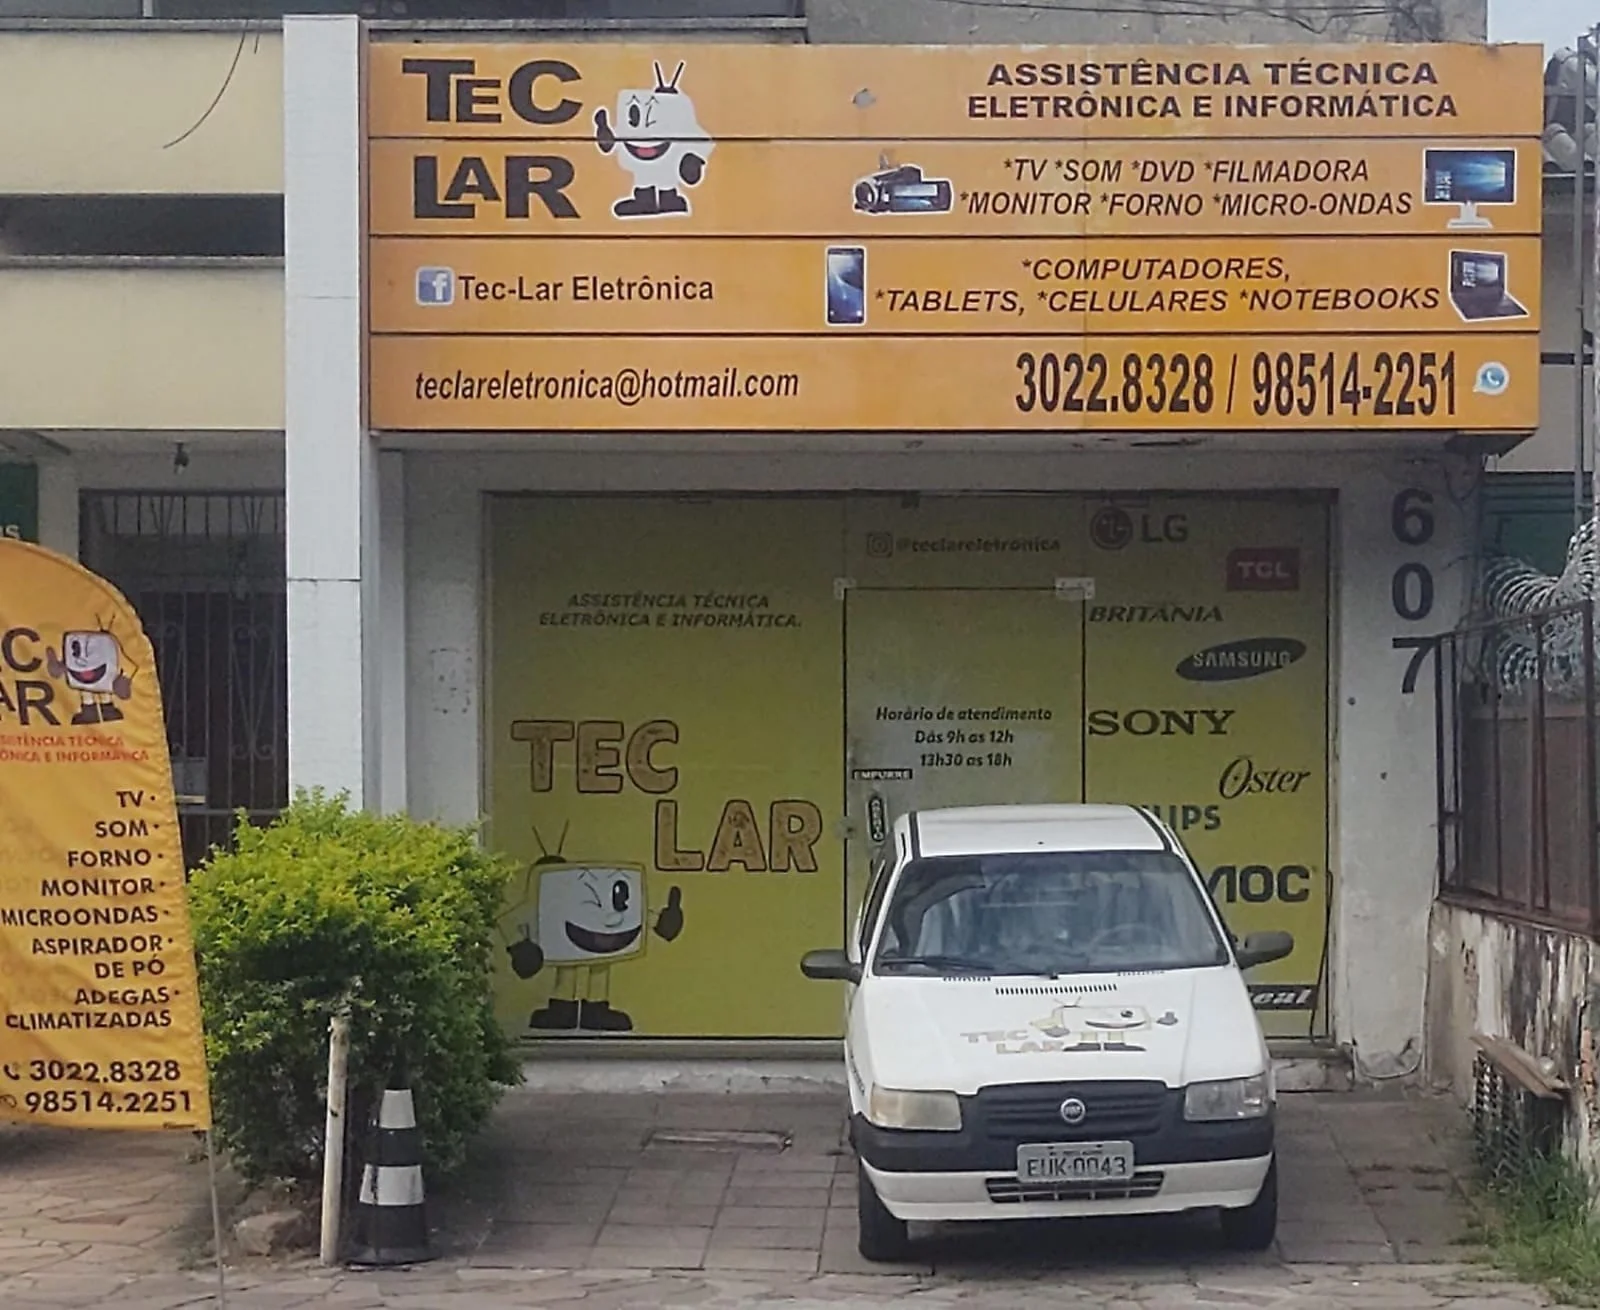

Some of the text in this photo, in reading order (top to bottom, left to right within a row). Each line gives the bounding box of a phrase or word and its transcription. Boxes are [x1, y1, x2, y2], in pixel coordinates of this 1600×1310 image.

[987, 58, 1438, 86] ASSISTÊNCIA TÉCNICA
[403, 59, 582, 124] TEC
[968, 89, 1458, 118] ELETRÔNICA E INFORMÁTICA
[414, 156, 580, 219] LAR
[459, 275, 563, 300] Tec-Lar
[572, 275, 714, 300] Eletrônica
[415, 368, 799, 405] teclareletronica@hotmail.com
[1016, 352, 1214, 414] 3022.8328
[1253, 351, 1456, 416] 98514-2251
[1141, 514, 1189, 543] LG
[1237, 561, 1290, 577] TCL
[568, 590, 769, 608] ASSISTÊNCIA TÉCNICA
[539, 611, 650, 627] ELETRÔNICA
[656, 612, 666, 627] E
[1193, 651, 1291, 667] SAMSUNG
[876, 706, 1052, 721] Horário de atendimento
[1088, 710, 1235, 736] SONY
[947, 729, 965, 744] 9h
[990, 729, 1014, 744] 12h
[510, 720, 679, 795] TEC
[920, 752, 963, 767] 13h30
[1219, 758, 1311, 800] Oster
[116, 790, 144, 808] TV
[95, 819, 149, 838] SOM
[655, 799, 822, 873] LAR
[68, 848, 151, 868] FORNO
[41, 878, 155, 897] MONITOR
[1, 905, 158, 927] MICROONDAS
[32, 935, 163, 956] ASPIRADOR
[94, 953, 165, 979] DE PÓ
[74, 986, 170, 1006] ADEGAS
[5, 1009, 172, 1031] CLIMATIZADAS
[960, 1029, 1029, 1043] TEC
[996, 1041, 1064, 1055] LAR
[29, 1060, 180, 1083] 3022.8328
[25, 1091, 191, 1113] 98514.2251
